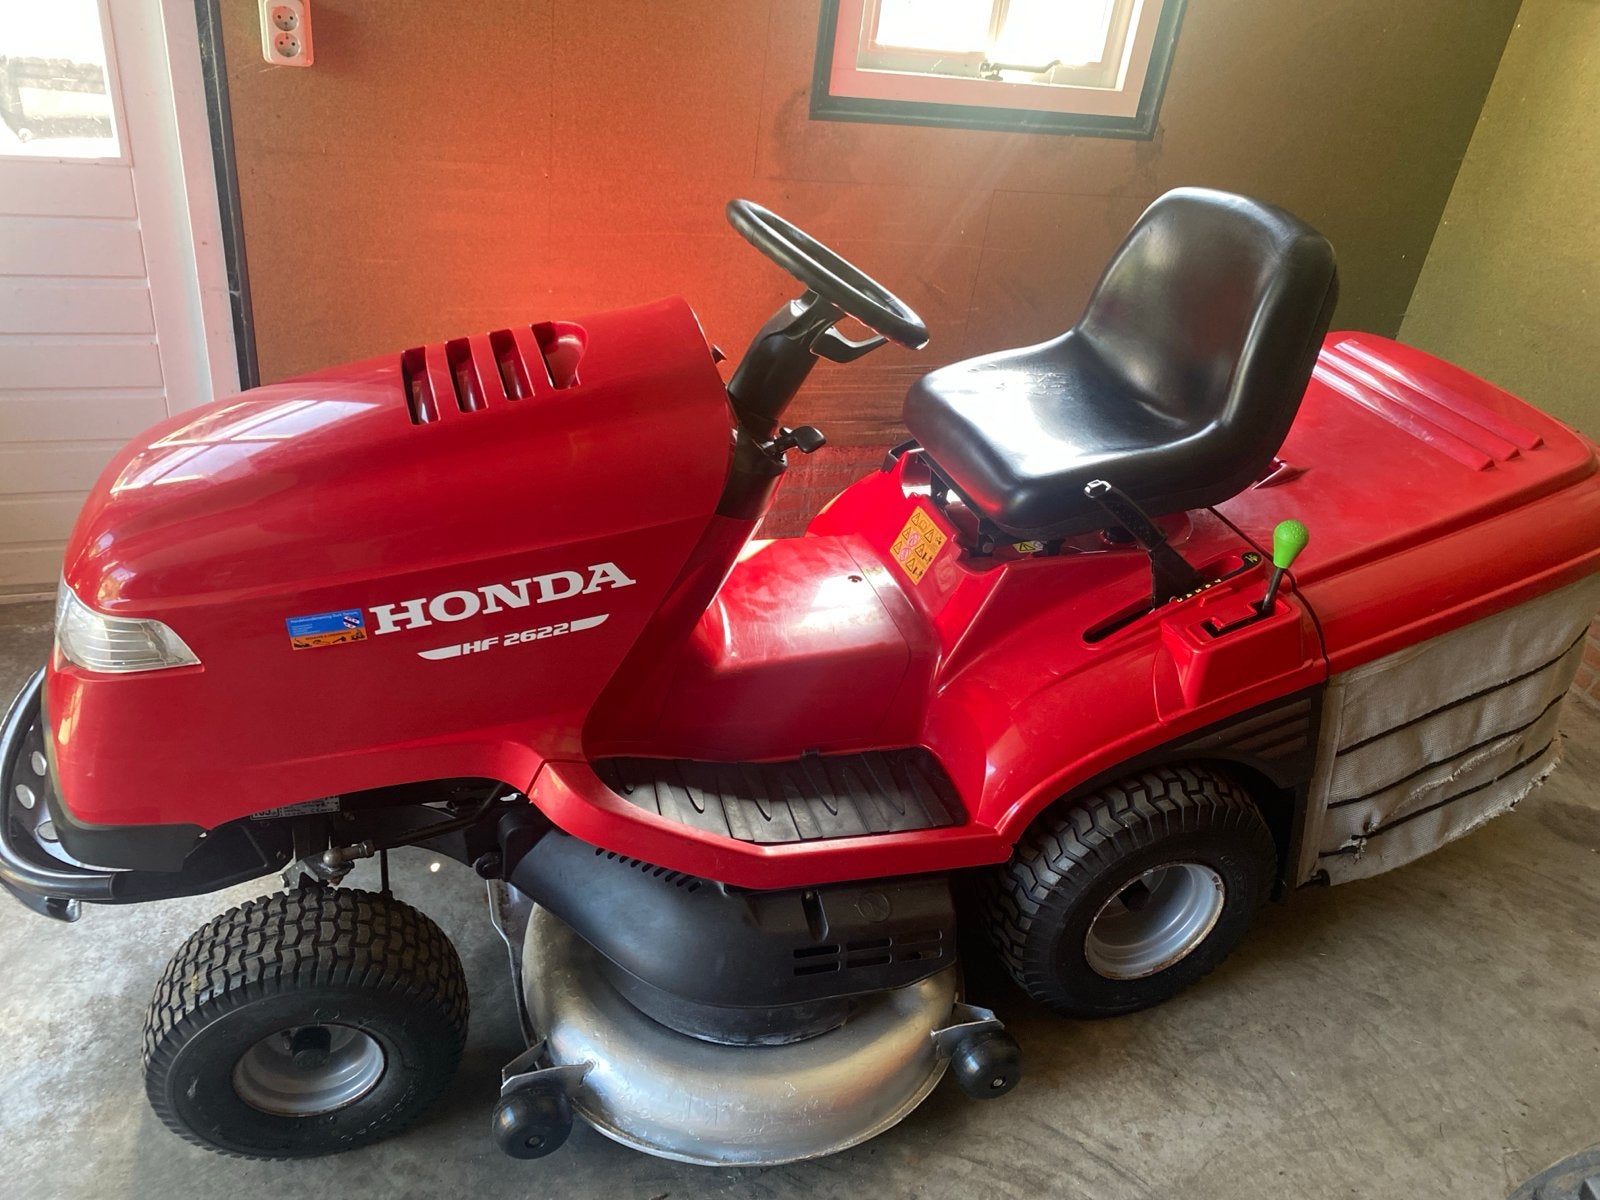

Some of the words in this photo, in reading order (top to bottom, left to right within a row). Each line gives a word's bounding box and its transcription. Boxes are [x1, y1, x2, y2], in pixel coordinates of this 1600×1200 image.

[368, 562, 637, 635] HONDA
[463, 637, 499, 655] HF
[503, 622, 569, 647] 2622
